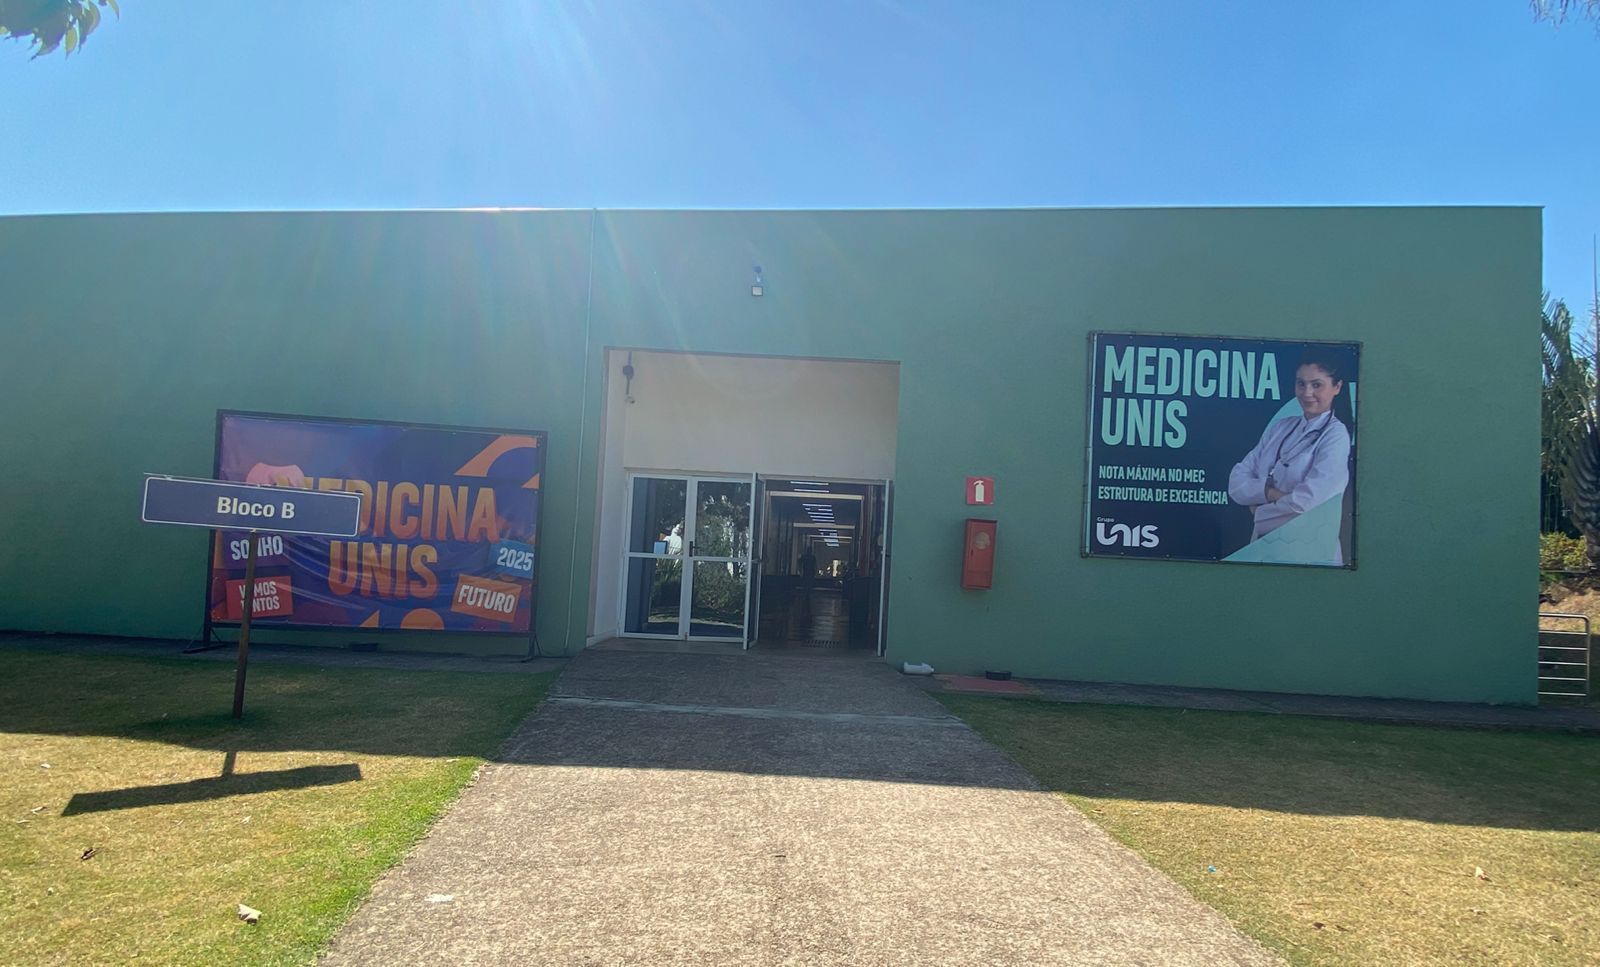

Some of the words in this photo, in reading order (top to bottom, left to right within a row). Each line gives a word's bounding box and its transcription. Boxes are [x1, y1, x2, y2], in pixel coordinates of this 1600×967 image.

[1103, 345, 1281, 400] MEDICINA
[1101, 397, 1188, 449] UNIS
[1099, 465, 1125, 480] NOTA
[1126, 464, 1167, 481] MÁXIMA
[1168, 468, 1183, 482] NO
[1184, 469, 1206, 483] MEC
[217, 496, 275, 517] Bloco
[281, 502, 295, 519] B
[1098, 486, 1154, 502] ESTRUTURA
[1155, 488, 1169, 502] DE
[1169, 487, 1229, 505] EXCELÊNCIA
[278, 476, 499, 543] DICINA
[328, 540, 438, 598] UNIS
[496, 547, 534, 571] 2025
[239, 581, 277, 599] VMOS
[458, 584, 515, 614] FUTURO
